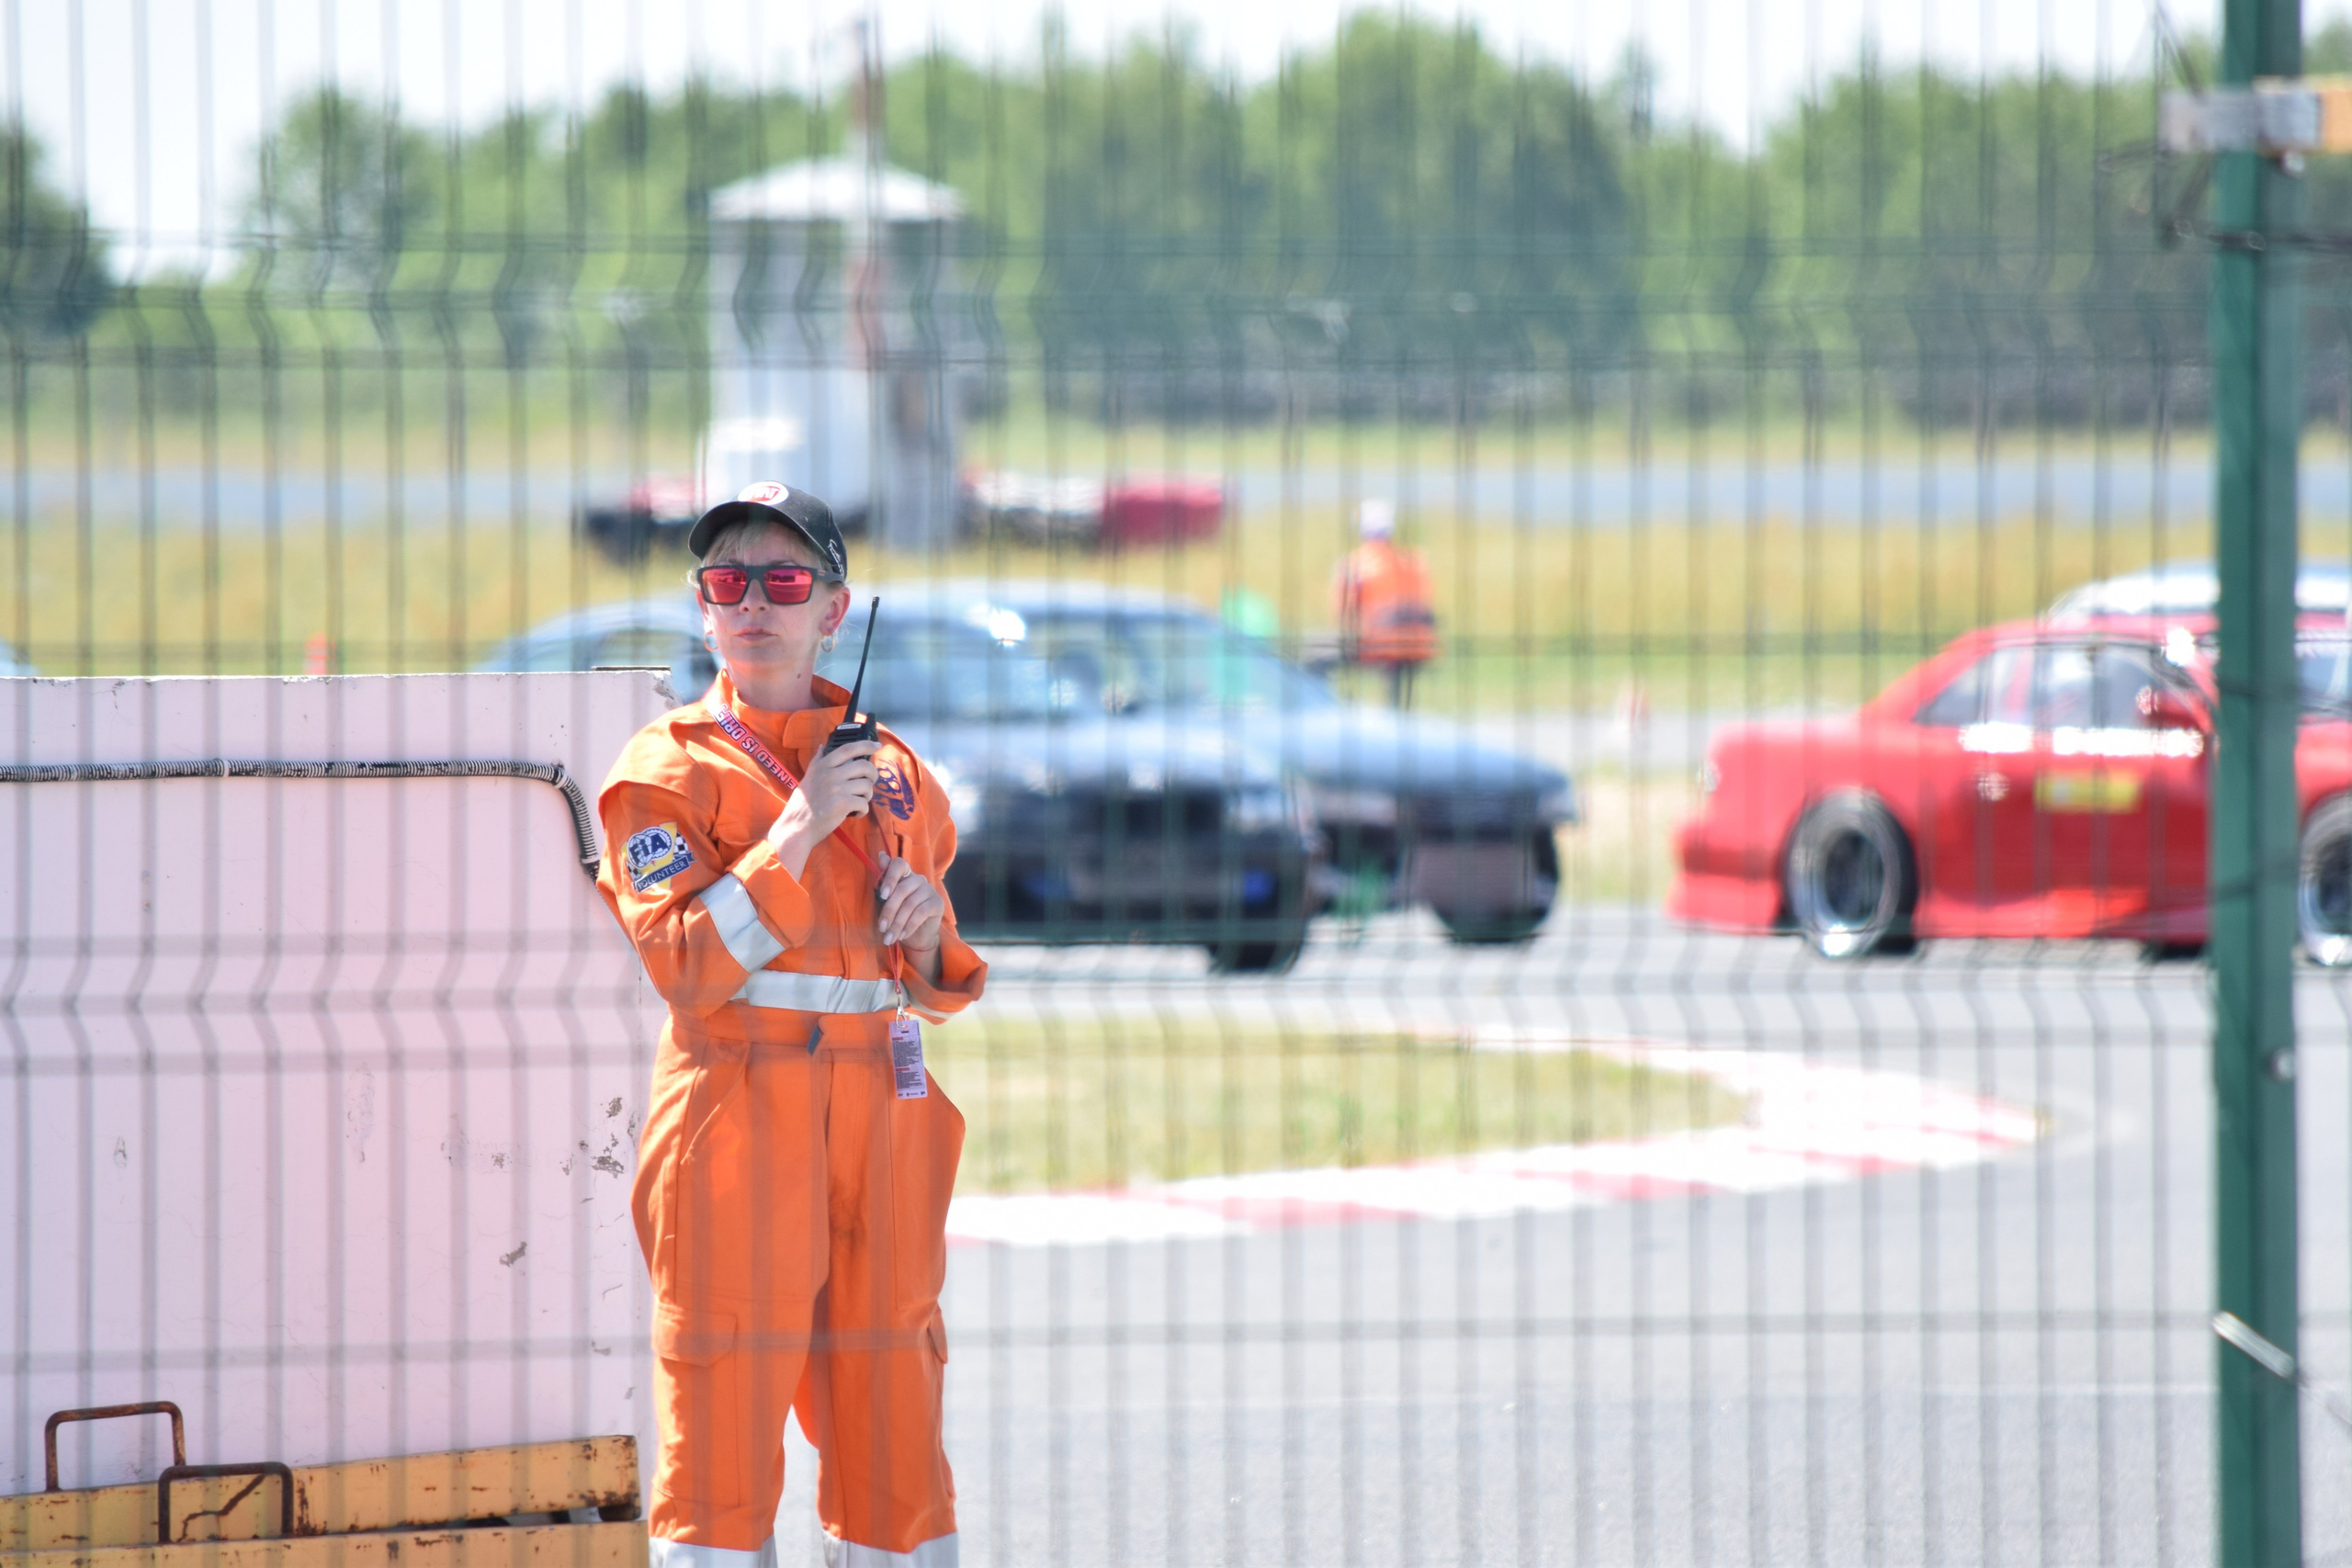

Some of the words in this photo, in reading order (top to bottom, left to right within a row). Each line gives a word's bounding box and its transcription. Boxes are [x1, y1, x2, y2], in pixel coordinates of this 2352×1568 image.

[741, 736, 760, 754] IS
[756, 750, 789, 783] NEED
[787, 778, 798, 790] E
[638, 861, 686, 889] VOLUNTEER
